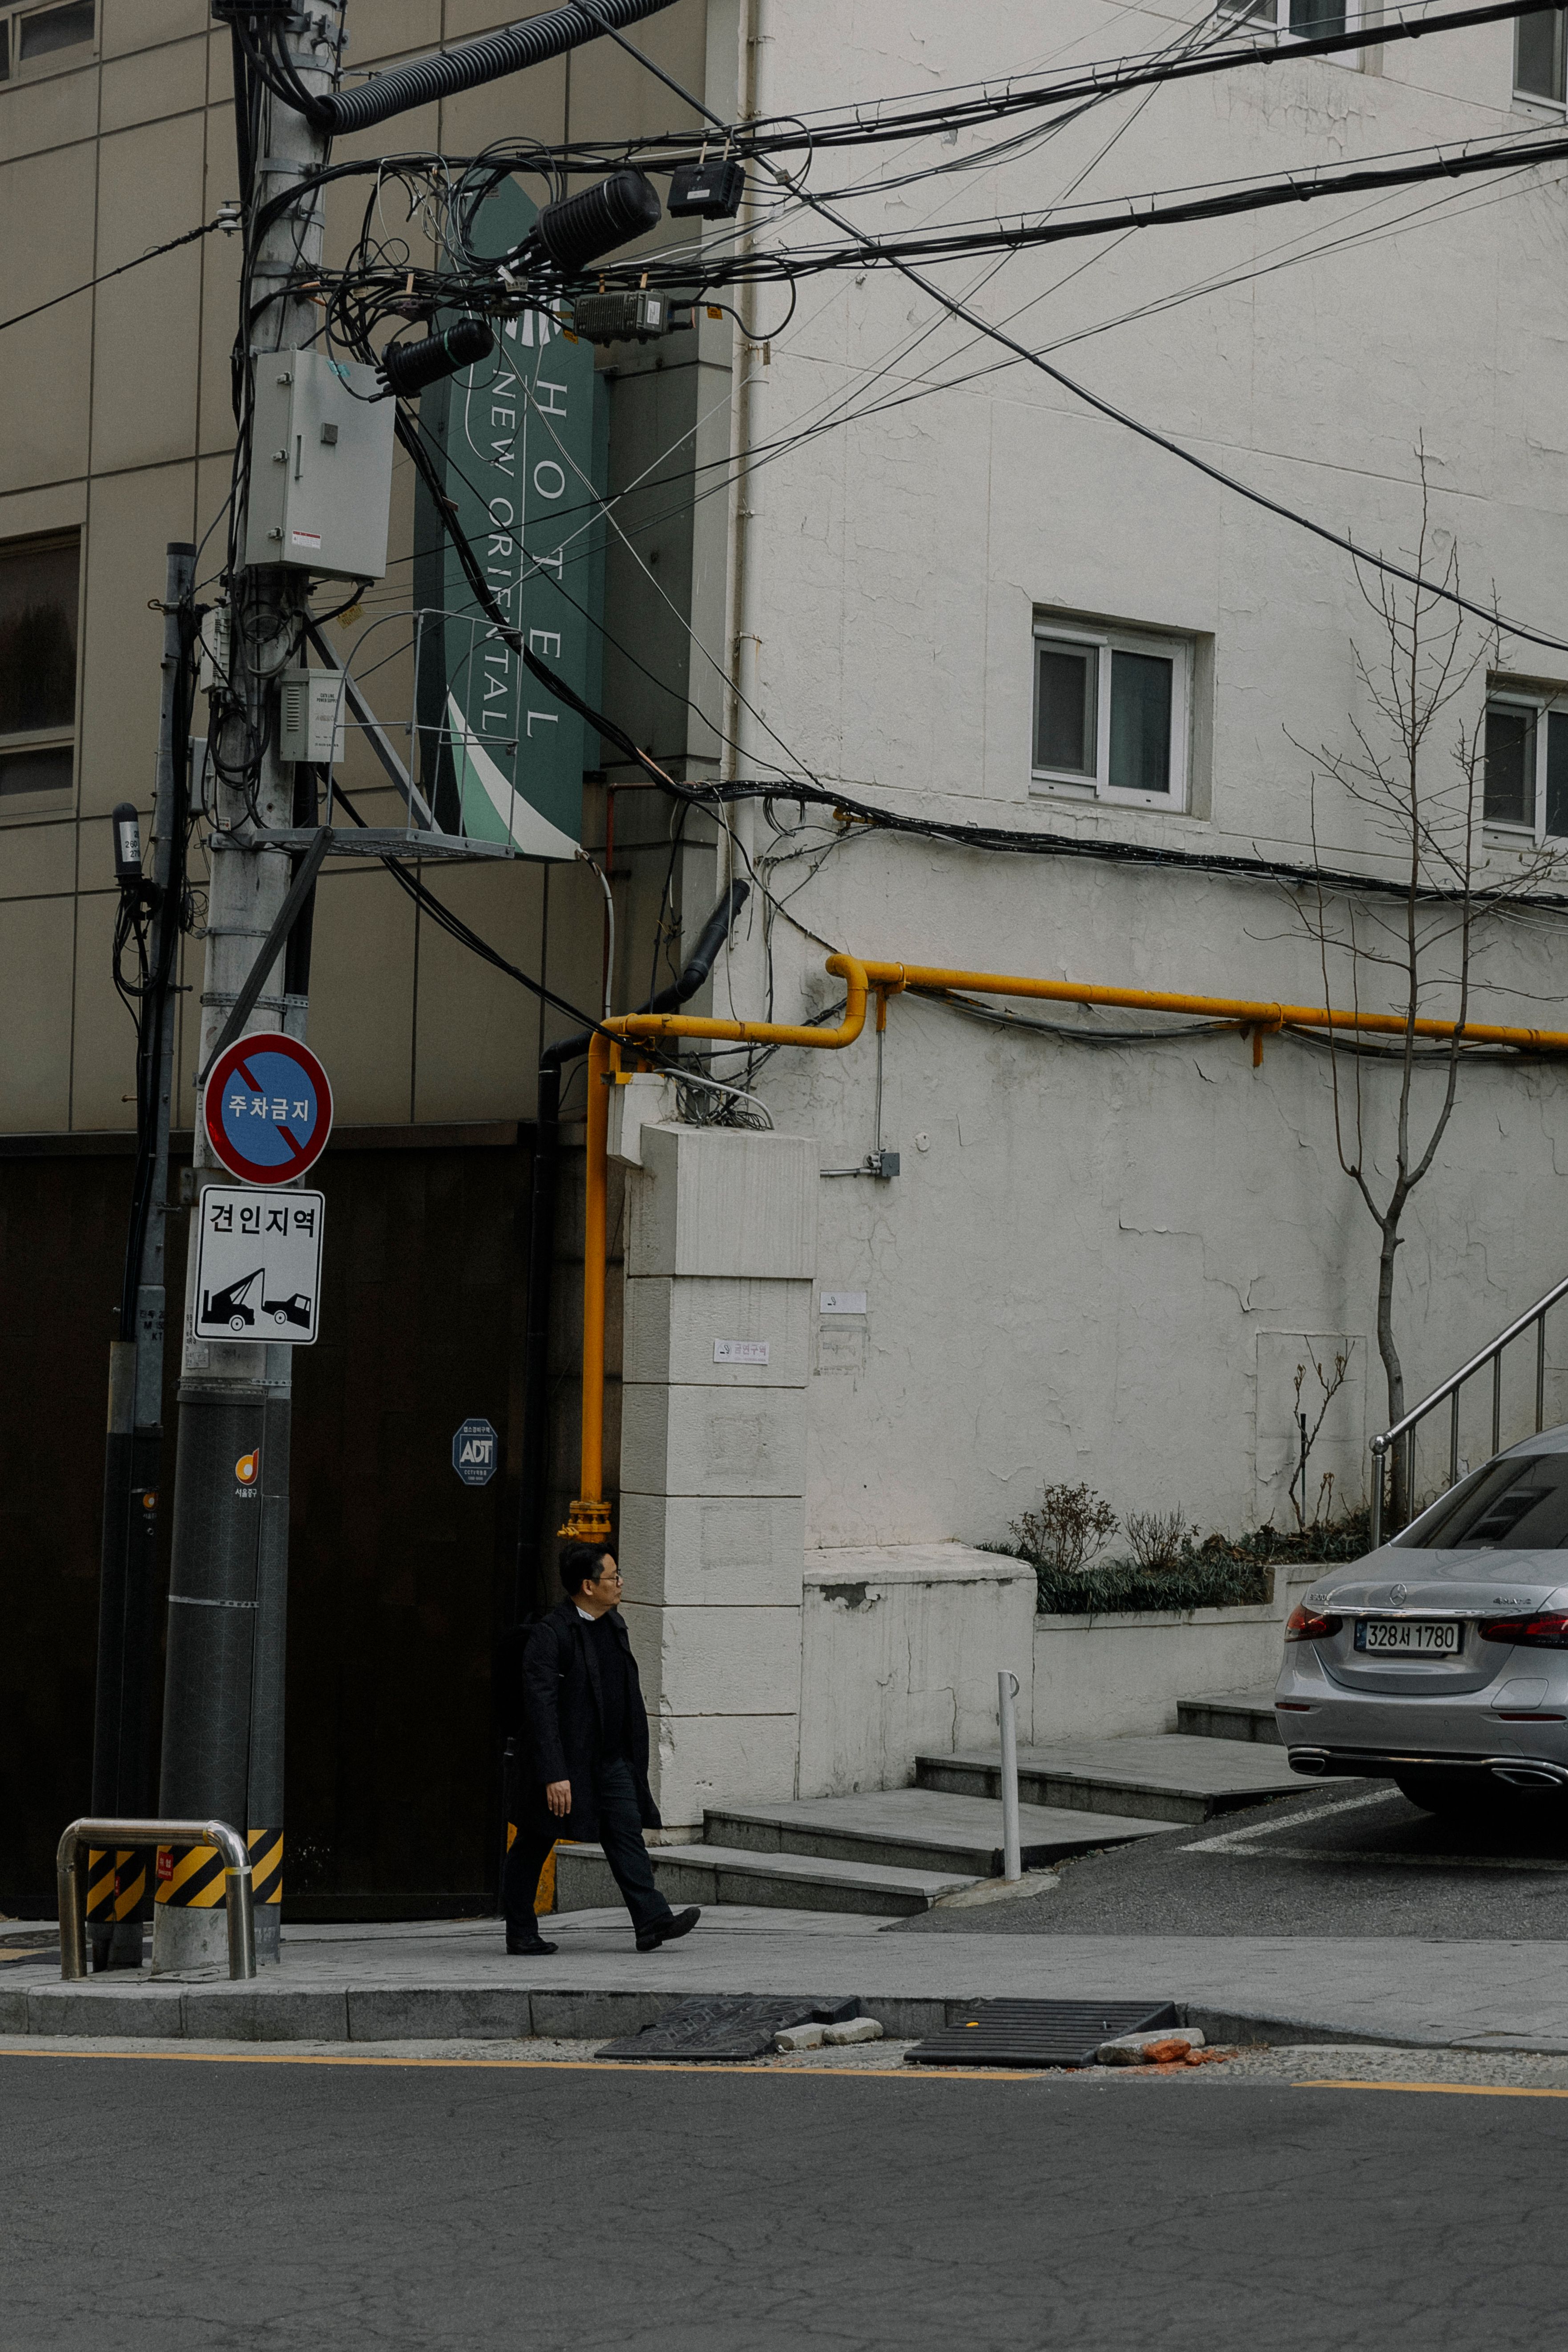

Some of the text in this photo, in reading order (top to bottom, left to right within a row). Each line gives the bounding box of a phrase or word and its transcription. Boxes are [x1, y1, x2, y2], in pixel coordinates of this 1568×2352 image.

[490, 369, 516, 478] NEW
[527, 380, 568, 738] HOTEL
[229, 1095, 309, 1122] 주차금지
[210, 1204, 315, 1238] 견인지역
[734, 1343, 766, 1356] 금연구역
[460, 1440, 493, 1464] ADT
[235, 1488, 257, 1498] 서울중구
[1368, 1625, 1454, 1648] 328서 1780
